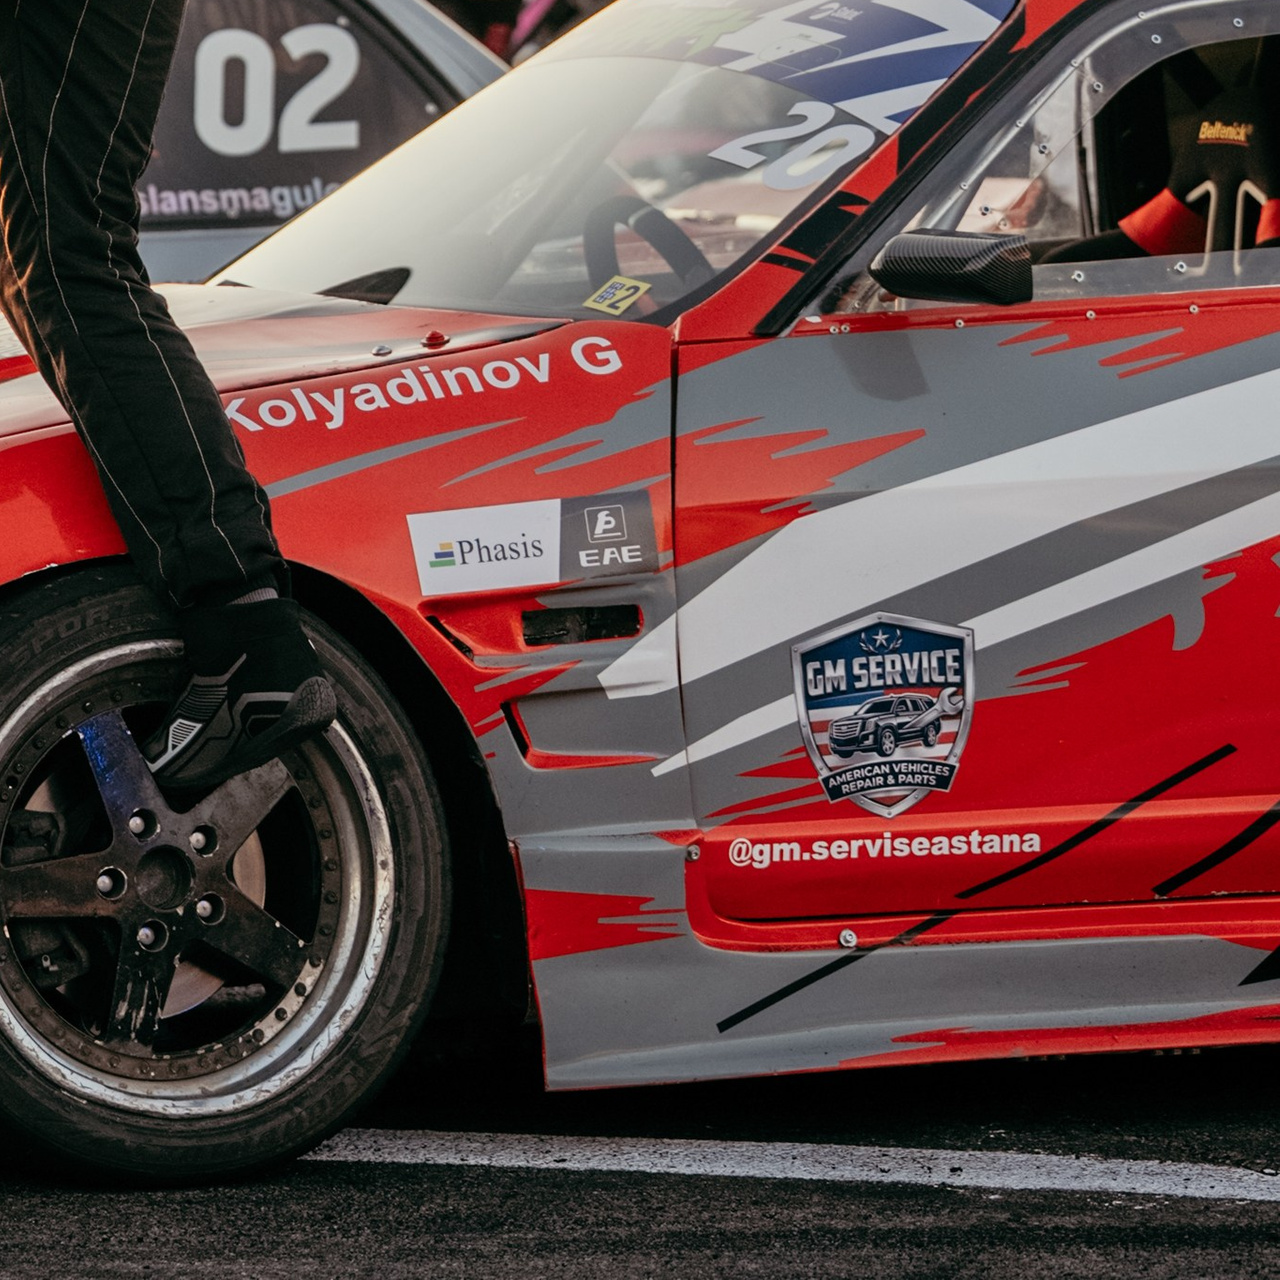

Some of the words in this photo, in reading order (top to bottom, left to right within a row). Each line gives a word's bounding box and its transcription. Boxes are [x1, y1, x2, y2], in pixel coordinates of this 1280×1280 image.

[194, 23, 360, 157] 02
[707, 100, 876, 191] 20
[606, 284, 641, 310] 2
[224, 351, 550, 431] Kolyadinov
[570, 335, 623, 376] G
[458, 532, 545, 566] Phasis
[578, 544, 643, 568] EAE
[806, 658, 848, 697] GM
[852, 648, 962, 689] SERVICE
[828, 761, 891, 788] AMERICAN
[892, 762, 950, 777] VEHICLES
[841, 776, 885, 795] REPAIR
[886, 774, 895, 785] &
[898, 774, 937, 786] PARTS
[729, 829, 1041, 869] @gm.serviseastana
